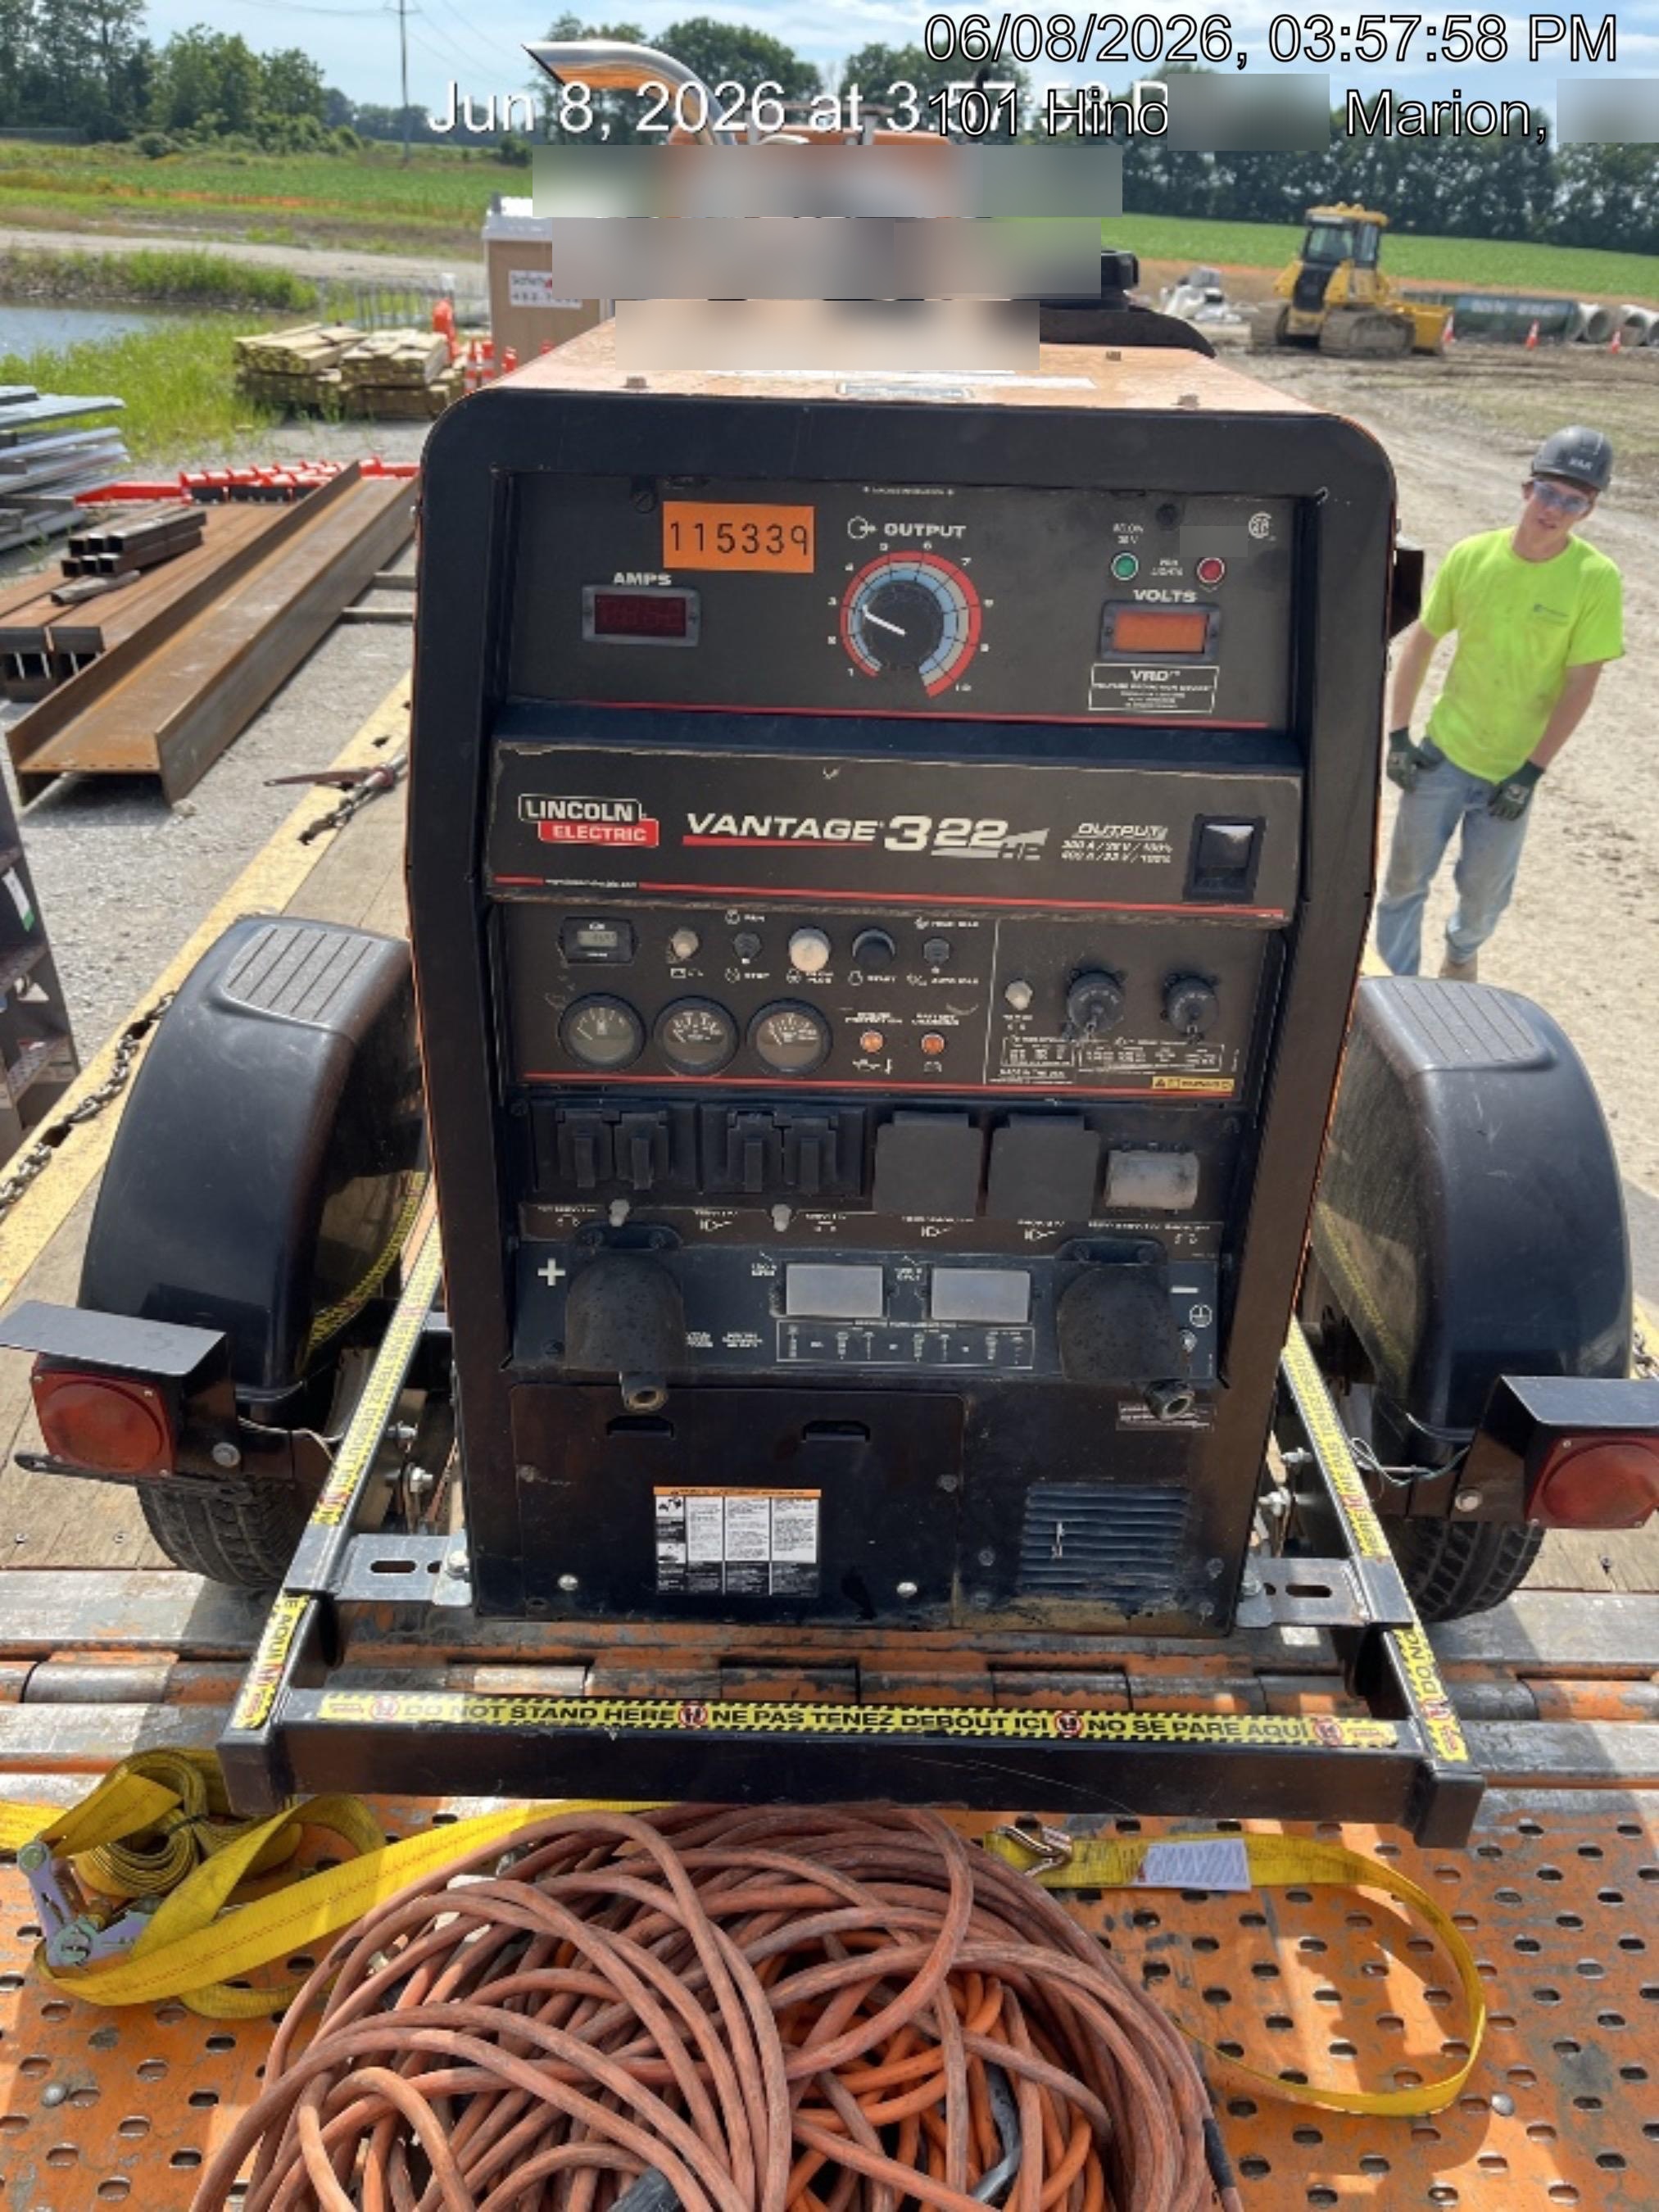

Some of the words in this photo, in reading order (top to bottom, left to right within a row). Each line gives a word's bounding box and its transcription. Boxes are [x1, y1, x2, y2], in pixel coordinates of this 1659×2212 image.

[670, 521, 809, 556] 115339
[884, 523, 967, 538] OUTPUT
[614, 572, 672, 586] AMPS
[1134, 589, 1198, 603] VOLTS
[524, 800, 633, 823] LINCOLN
[551, 823, 648, 843] ELECTRIC
[687, 813, 879, 840] VANTAGE
[884, 815, 1009, 852] 322
[1078, 822, 1163, 837] OUTPUT
[451, 1704, 505, 1719] NOT
[510, 1705, 598, 1721] STAND
[605, 1707, 675, 1722] HERE
[712, 1709, 748, 1722] NE
[754, 1710, 805, 1725] PAS
[810, 1711, 893, 1726] TENEZ
[901, 1714, 1013, 1729] DEBOUT
[1014, 1716, 1049, 1730] ICI
[1088, 1720, 1127, 1733] NO
[1132, 1720, 1168, 1734] SE
[1172, 1720, 1241, 1736] PARE
